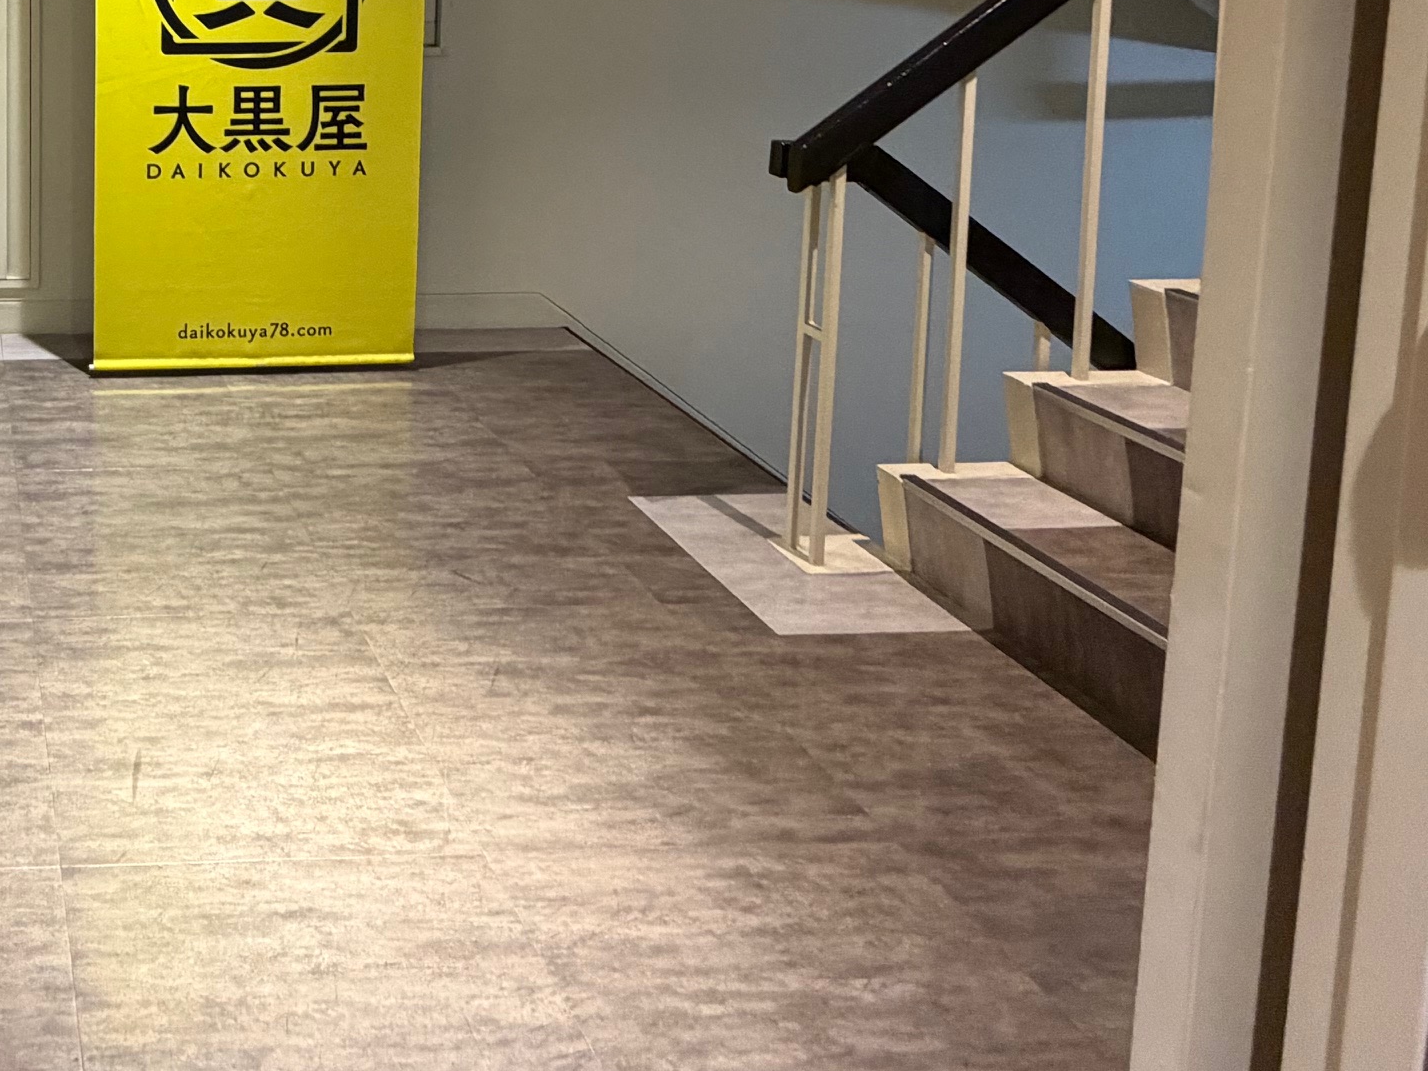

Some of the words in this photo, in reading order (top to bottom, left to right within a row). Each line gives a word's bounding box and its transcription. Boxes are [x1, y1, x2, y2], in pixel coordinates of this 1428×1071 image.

[147, 84, 368, 155] 大黒屋
[146, 159, 368, 180] DAIKOKUYA
[177, 322, 332, 344] daikokuya78.com
